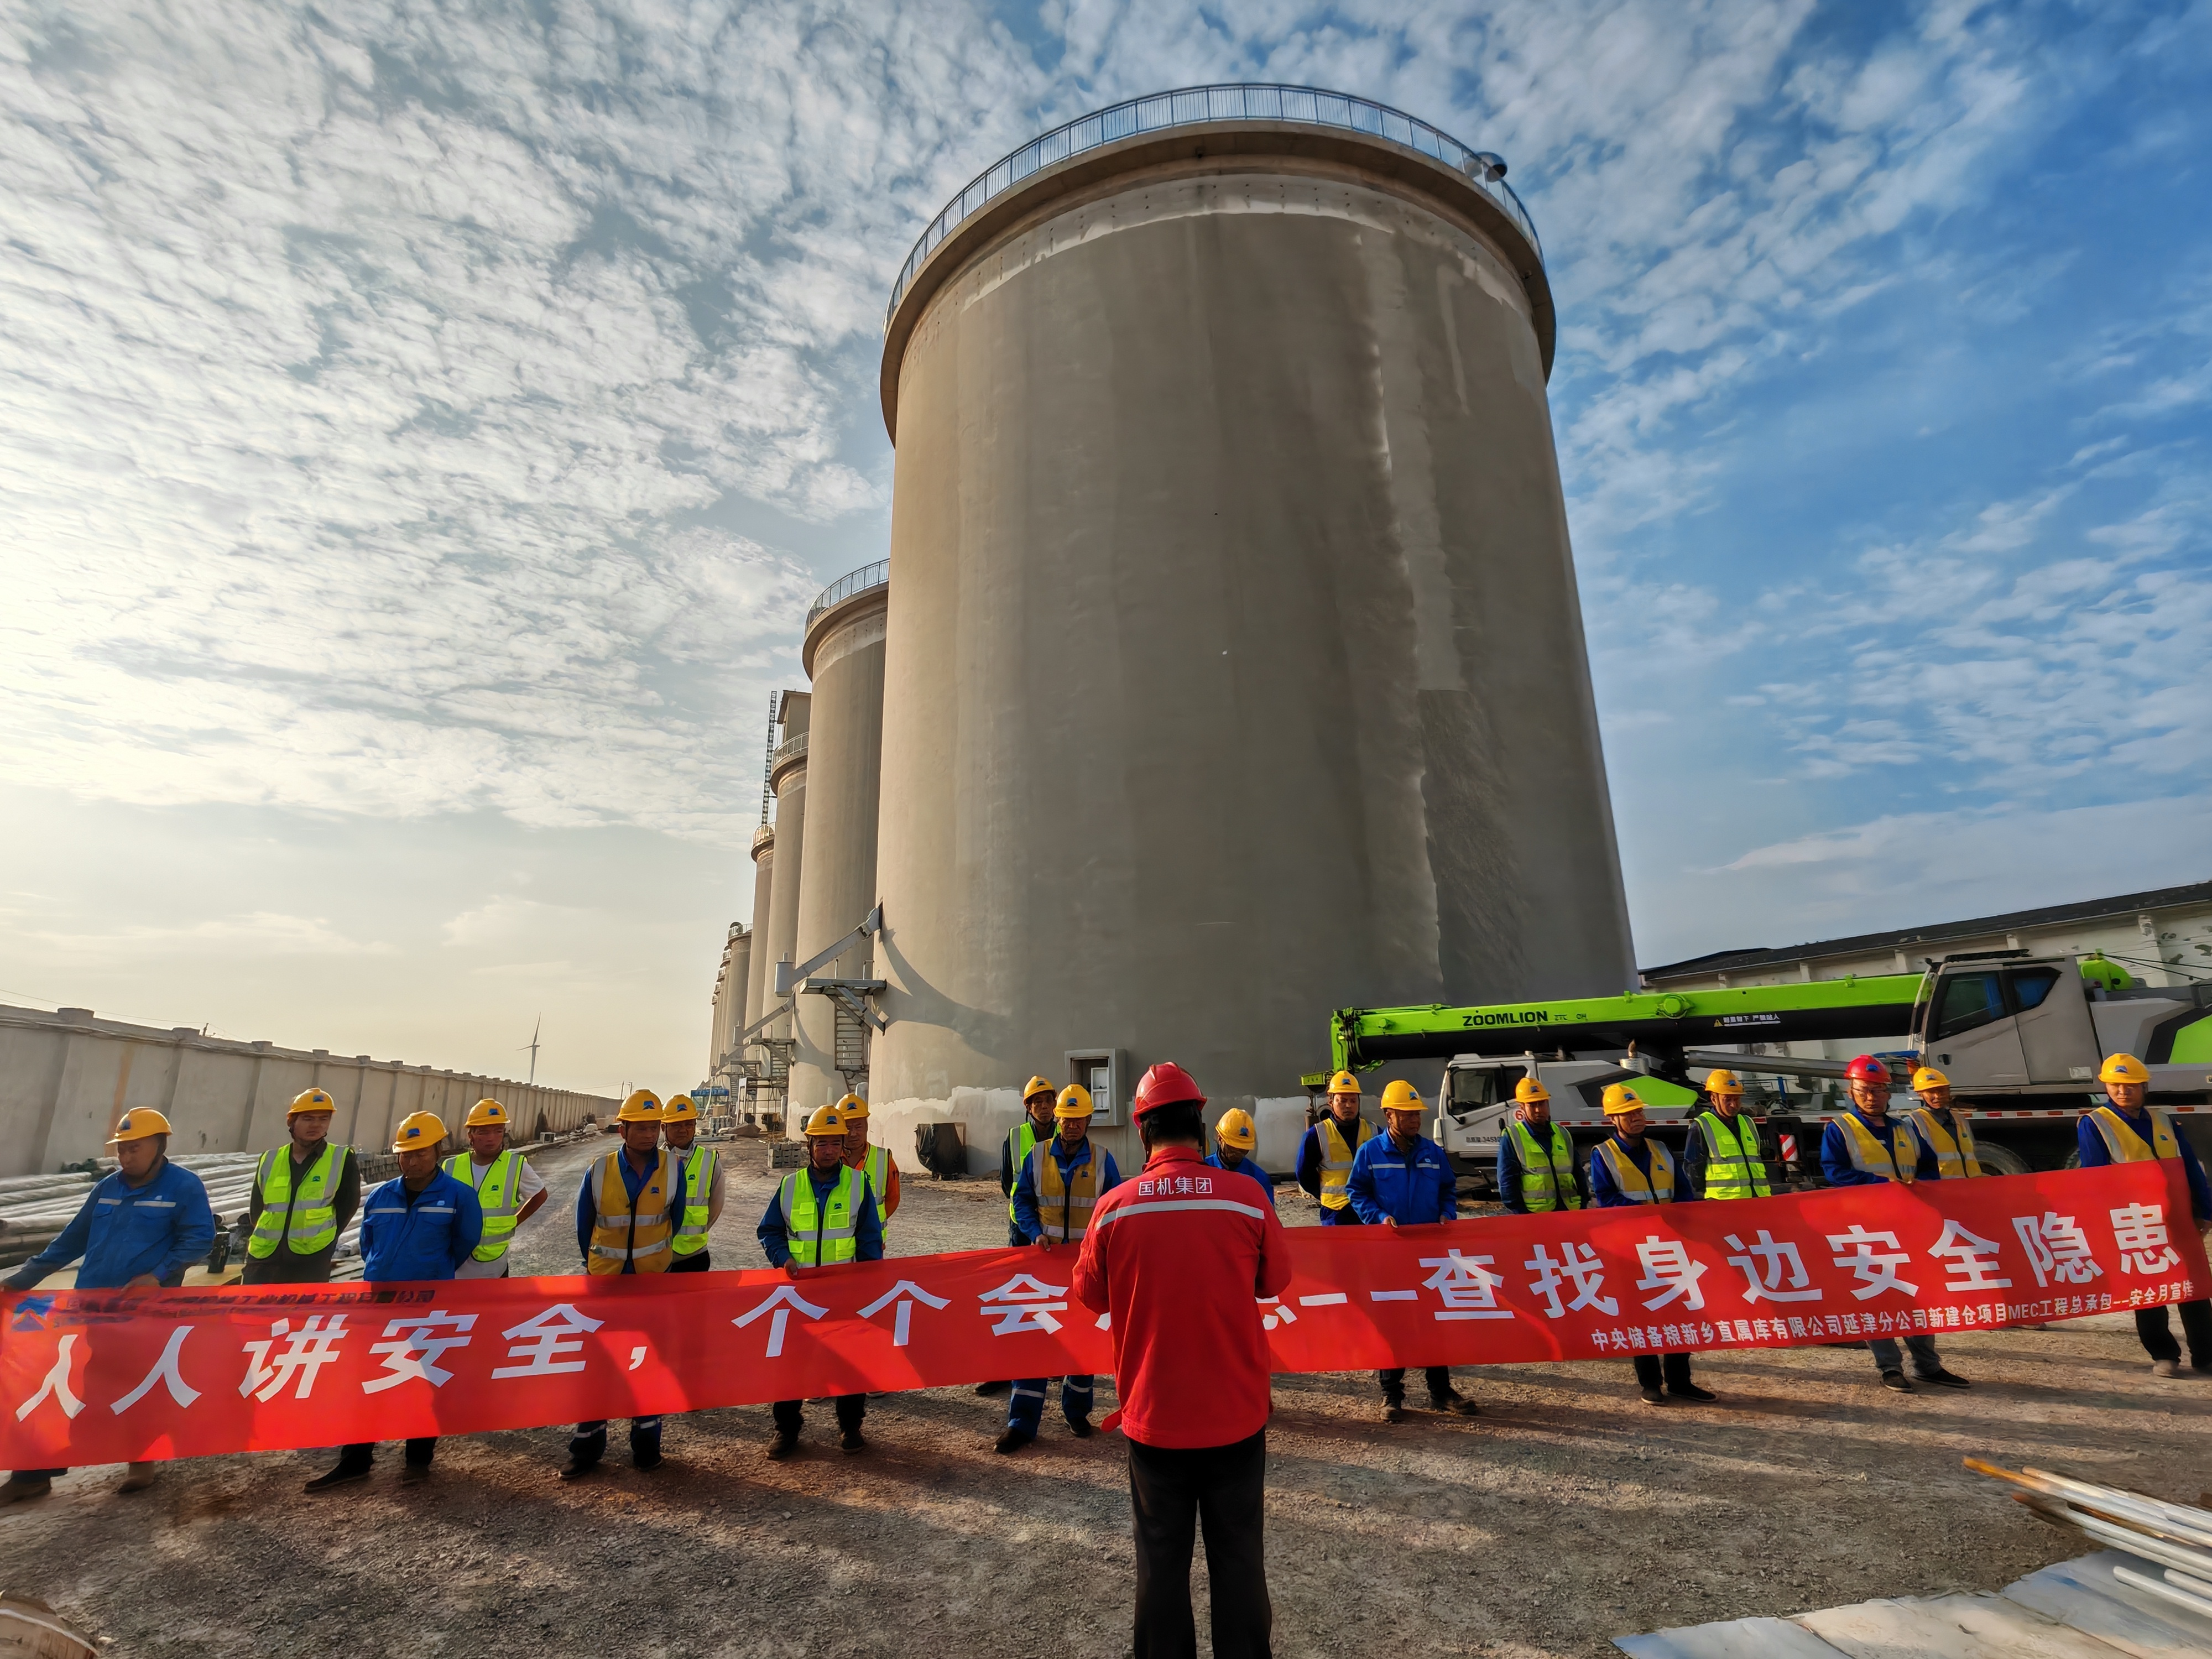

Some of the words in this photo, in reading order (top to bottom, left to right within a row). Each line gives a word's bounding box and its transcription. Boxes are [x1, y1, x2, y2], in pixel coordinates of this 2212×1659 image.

[1463, 1011, 1548, 1026] ZOOMLION
[1139, 1176, 1212, 1196] 国机集团
